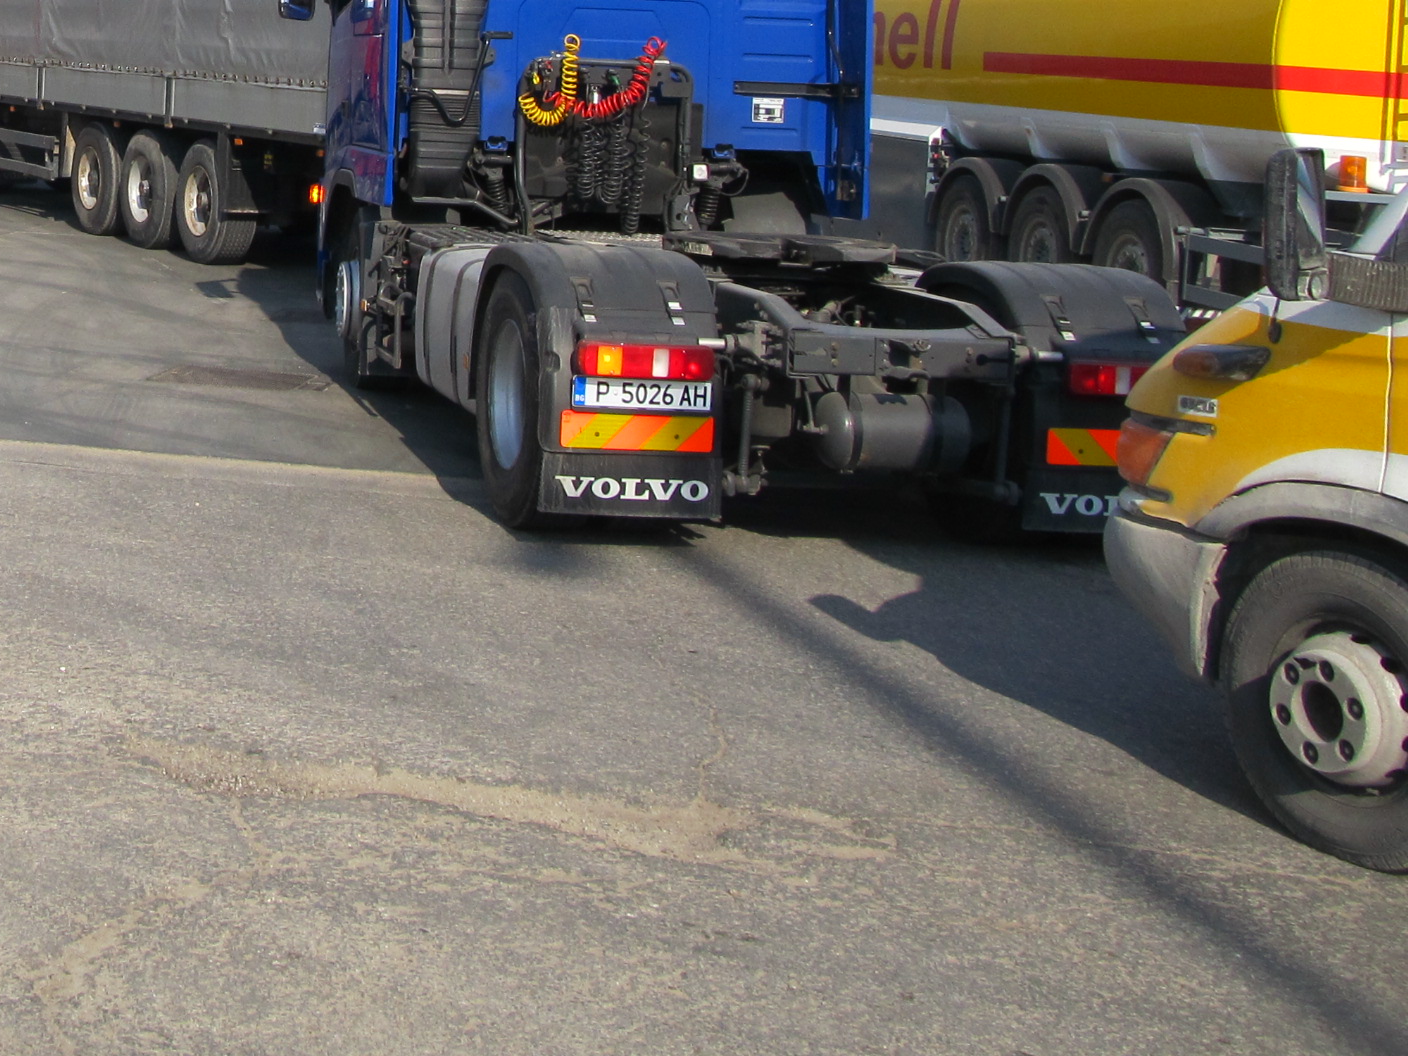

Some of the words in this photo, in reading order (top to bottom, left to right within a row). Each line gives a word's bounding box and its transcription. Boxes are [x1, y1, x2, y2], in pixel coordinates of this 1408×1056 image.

[574, 394, 585, 402] BG
[595, 381, 610, 403] P
[621, 382, 675, 406] 5026
[679, 385, 708, 408] AH
[554, 475, 710, 502] VOLVO
